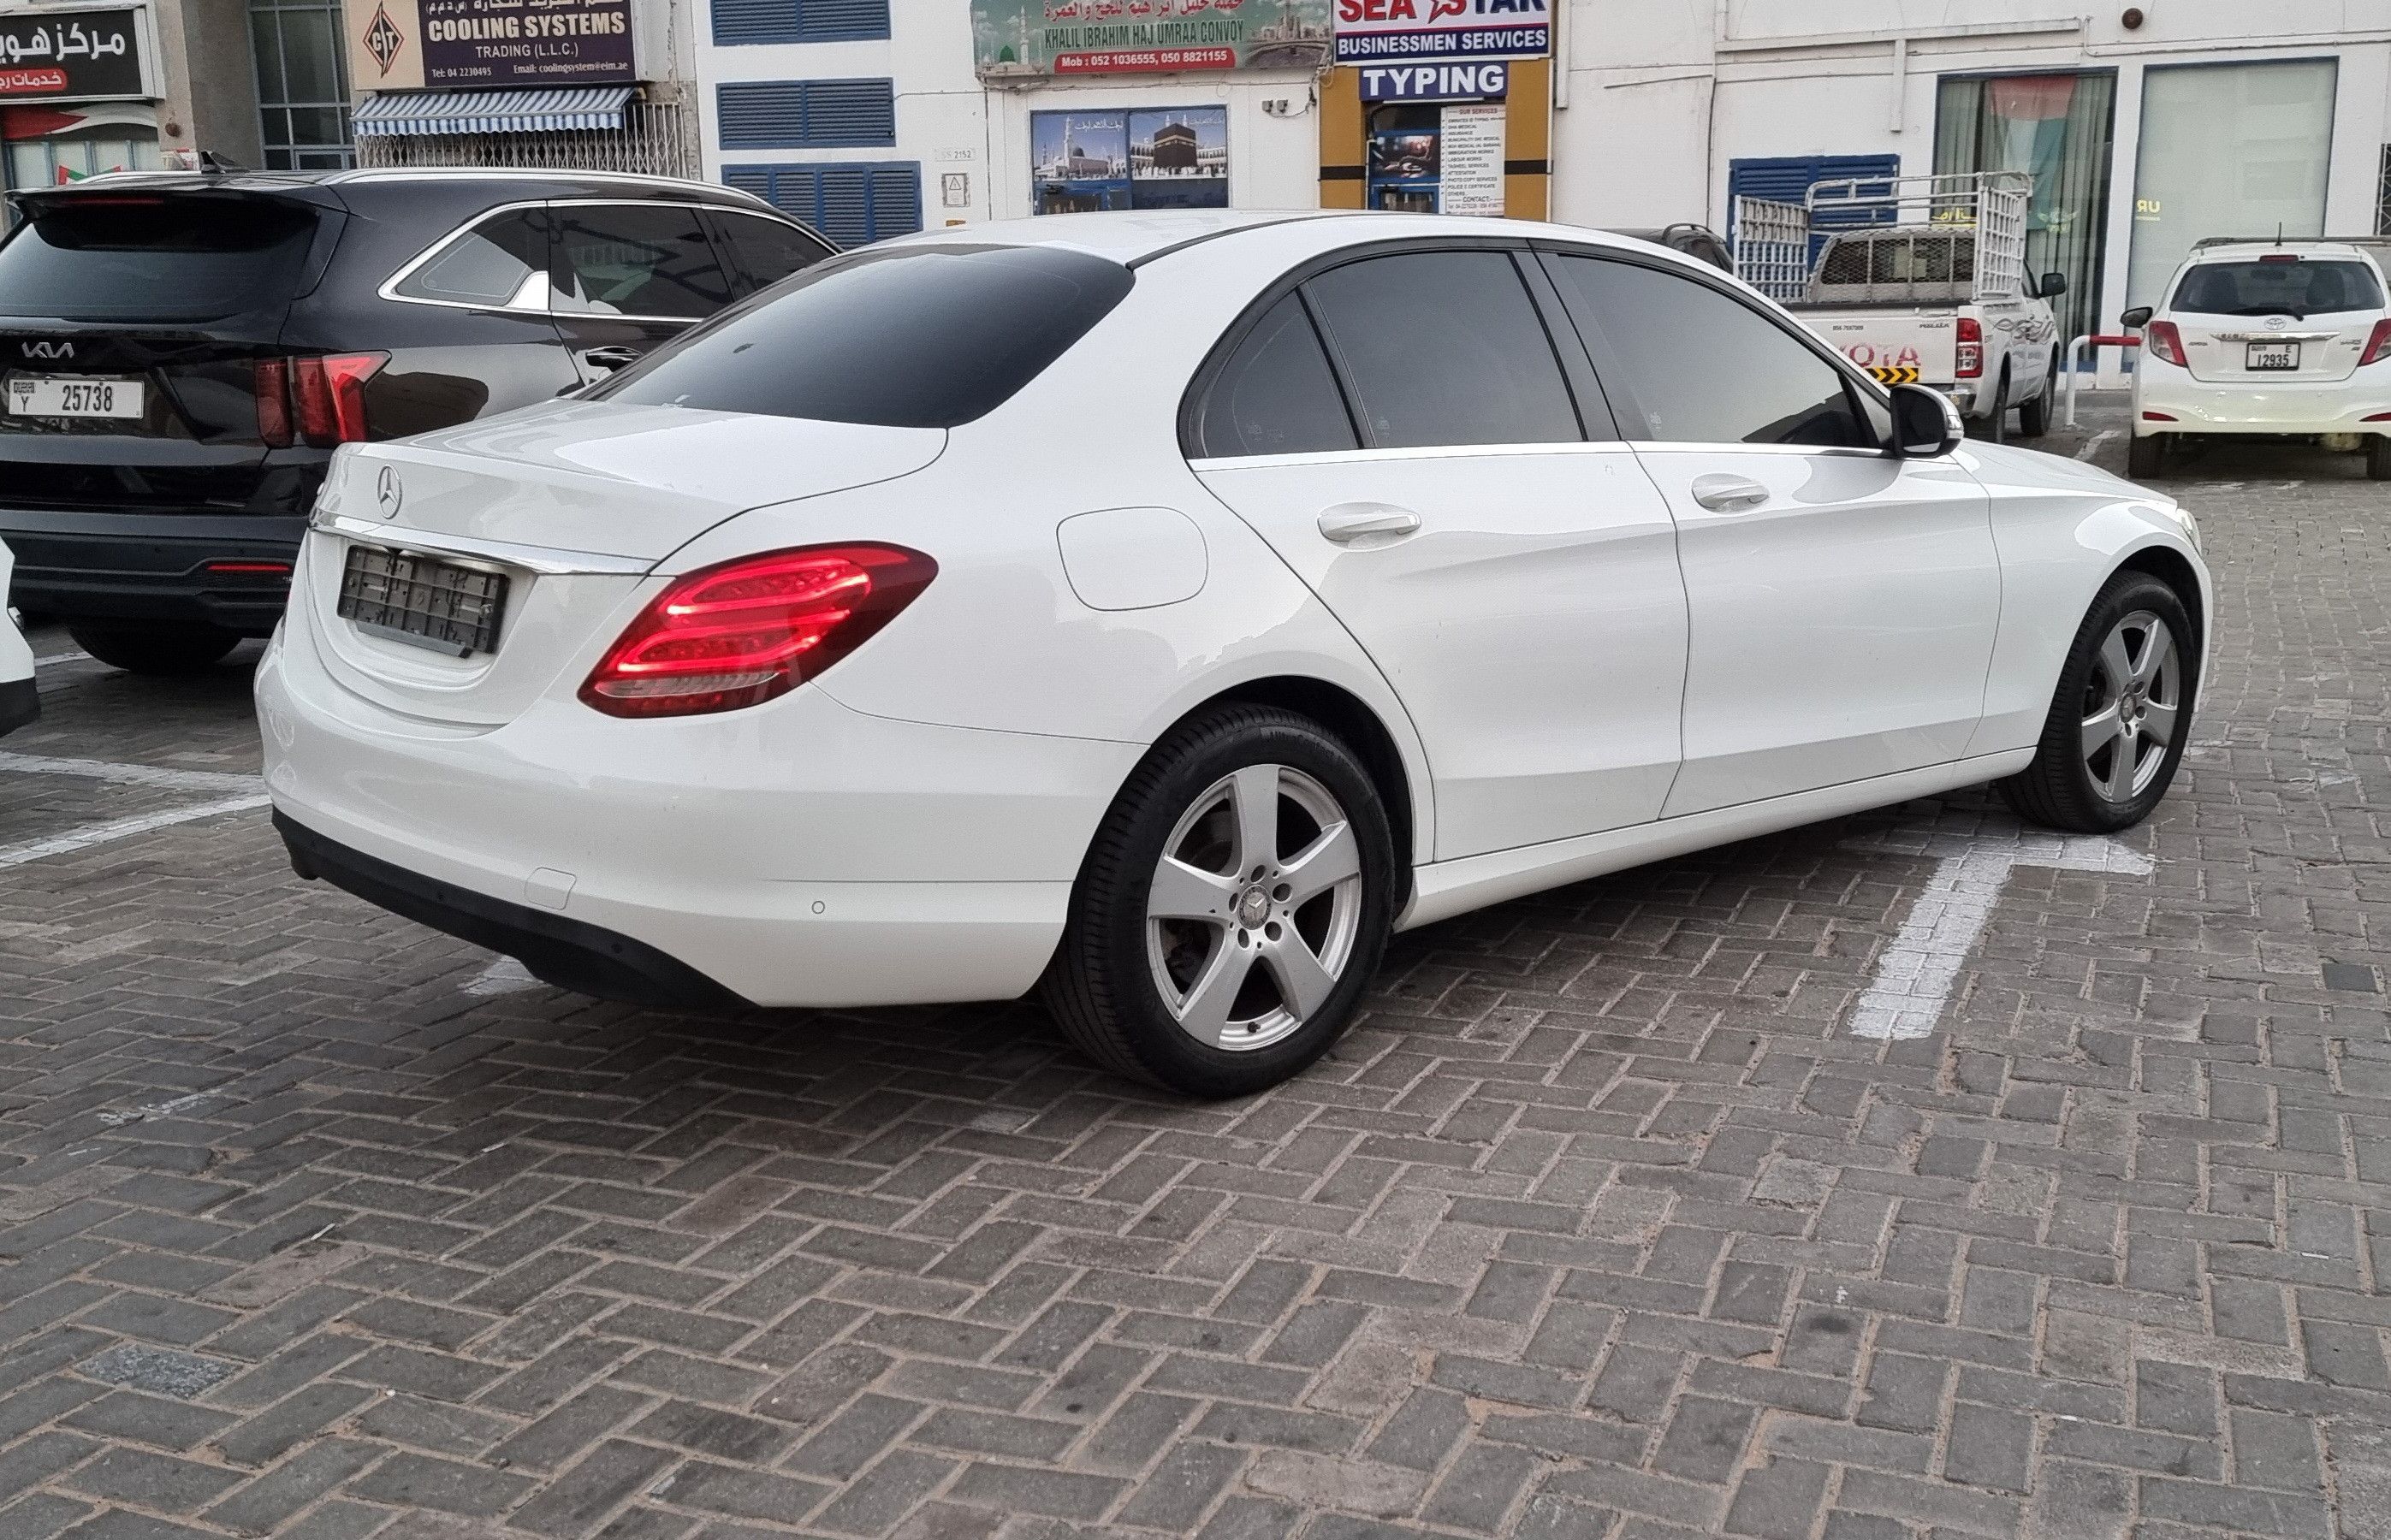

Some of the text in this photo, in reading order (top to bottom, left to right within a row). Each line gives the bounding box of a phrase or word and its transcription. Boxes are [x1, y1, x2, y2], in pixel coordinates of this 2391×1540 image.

[1339, 0, 1417, 22] SEA
[429, 11, 626, 42] COOLING SYSTEMS
[1045, 20, 1244, 49] KHALIL IBRAHIM HAJ UMRAA CONVOY
[56, 22, 126, 61] مركز
[1338, 29, 1546, 55] BUSINESSMEN SERVICES
[476, 42, 578, 59] TRADING (L.L.C.)
[1062, 56, 1083, 67] Mob
[1090, 55, 1110, 66] 052
[1161, 52, 1180, 63] 050
[1183, 50, 1228, 62] 8821155
[11, 71, 62, 86] خدمات
[448, 68, 458, 78] 04
[1362, 65, 1505, 97] TYPING
[21, 341, 75, 358] KIA
[2285, 345, 2292, 353] E
[2257, 353, 2290, 367] 12935
[21, 395, 29, 412] Y
[62, 384, 113, 412] 25738
